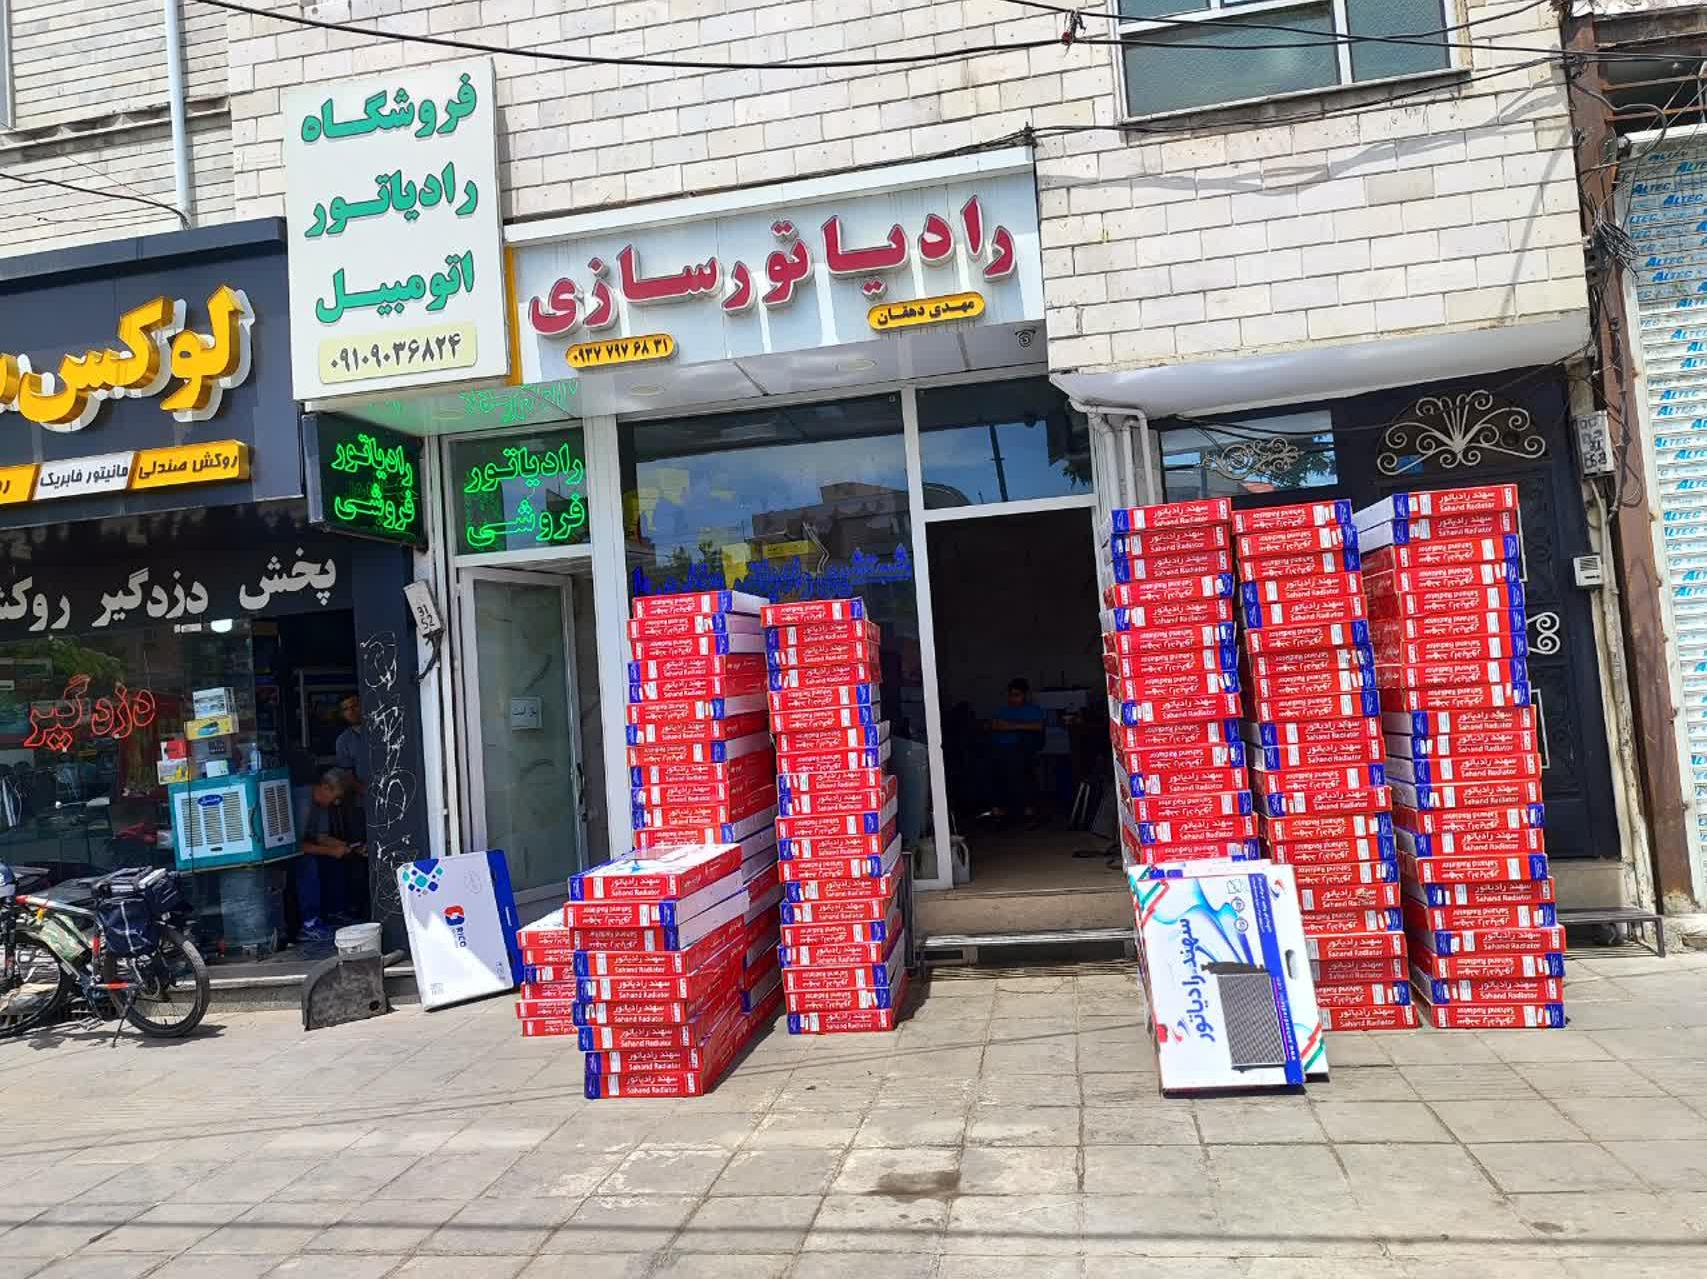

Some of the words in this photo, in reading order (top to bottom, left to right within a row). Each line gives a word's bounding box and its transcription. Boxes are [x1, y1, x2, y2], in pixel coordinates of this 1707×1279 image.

[301, 72, 477, 142] فروشگاه
[304, 161, 478, 238] رادیاتور
[315, 250, 475, 324] اتومبیل
[929, 300, 975, 318] مهدی
[18, 284, 247, 425] لوکس
[331, 333, 461, 372] ۰۹۱۰۹۰۳۶۸۲۴
[39, 468, 83, 490] فابریک
[86, 465, 129, 483] مانیتور
[192, 451, 238, 472] روکش
[331, 434, 413, 487] رادیاتور
[463, 443, 584, 493] رادیاتور
[335, 483, 415, 530] فروشی
[467, 491, 585, 547] فروشی
[92, 568, 208, 628] دزدگیر
[239, 548, 337, 610] پخش
[1180, 918, 1199, 966] سهند
[1183, 970, 1216, 1042] رادیاتور
